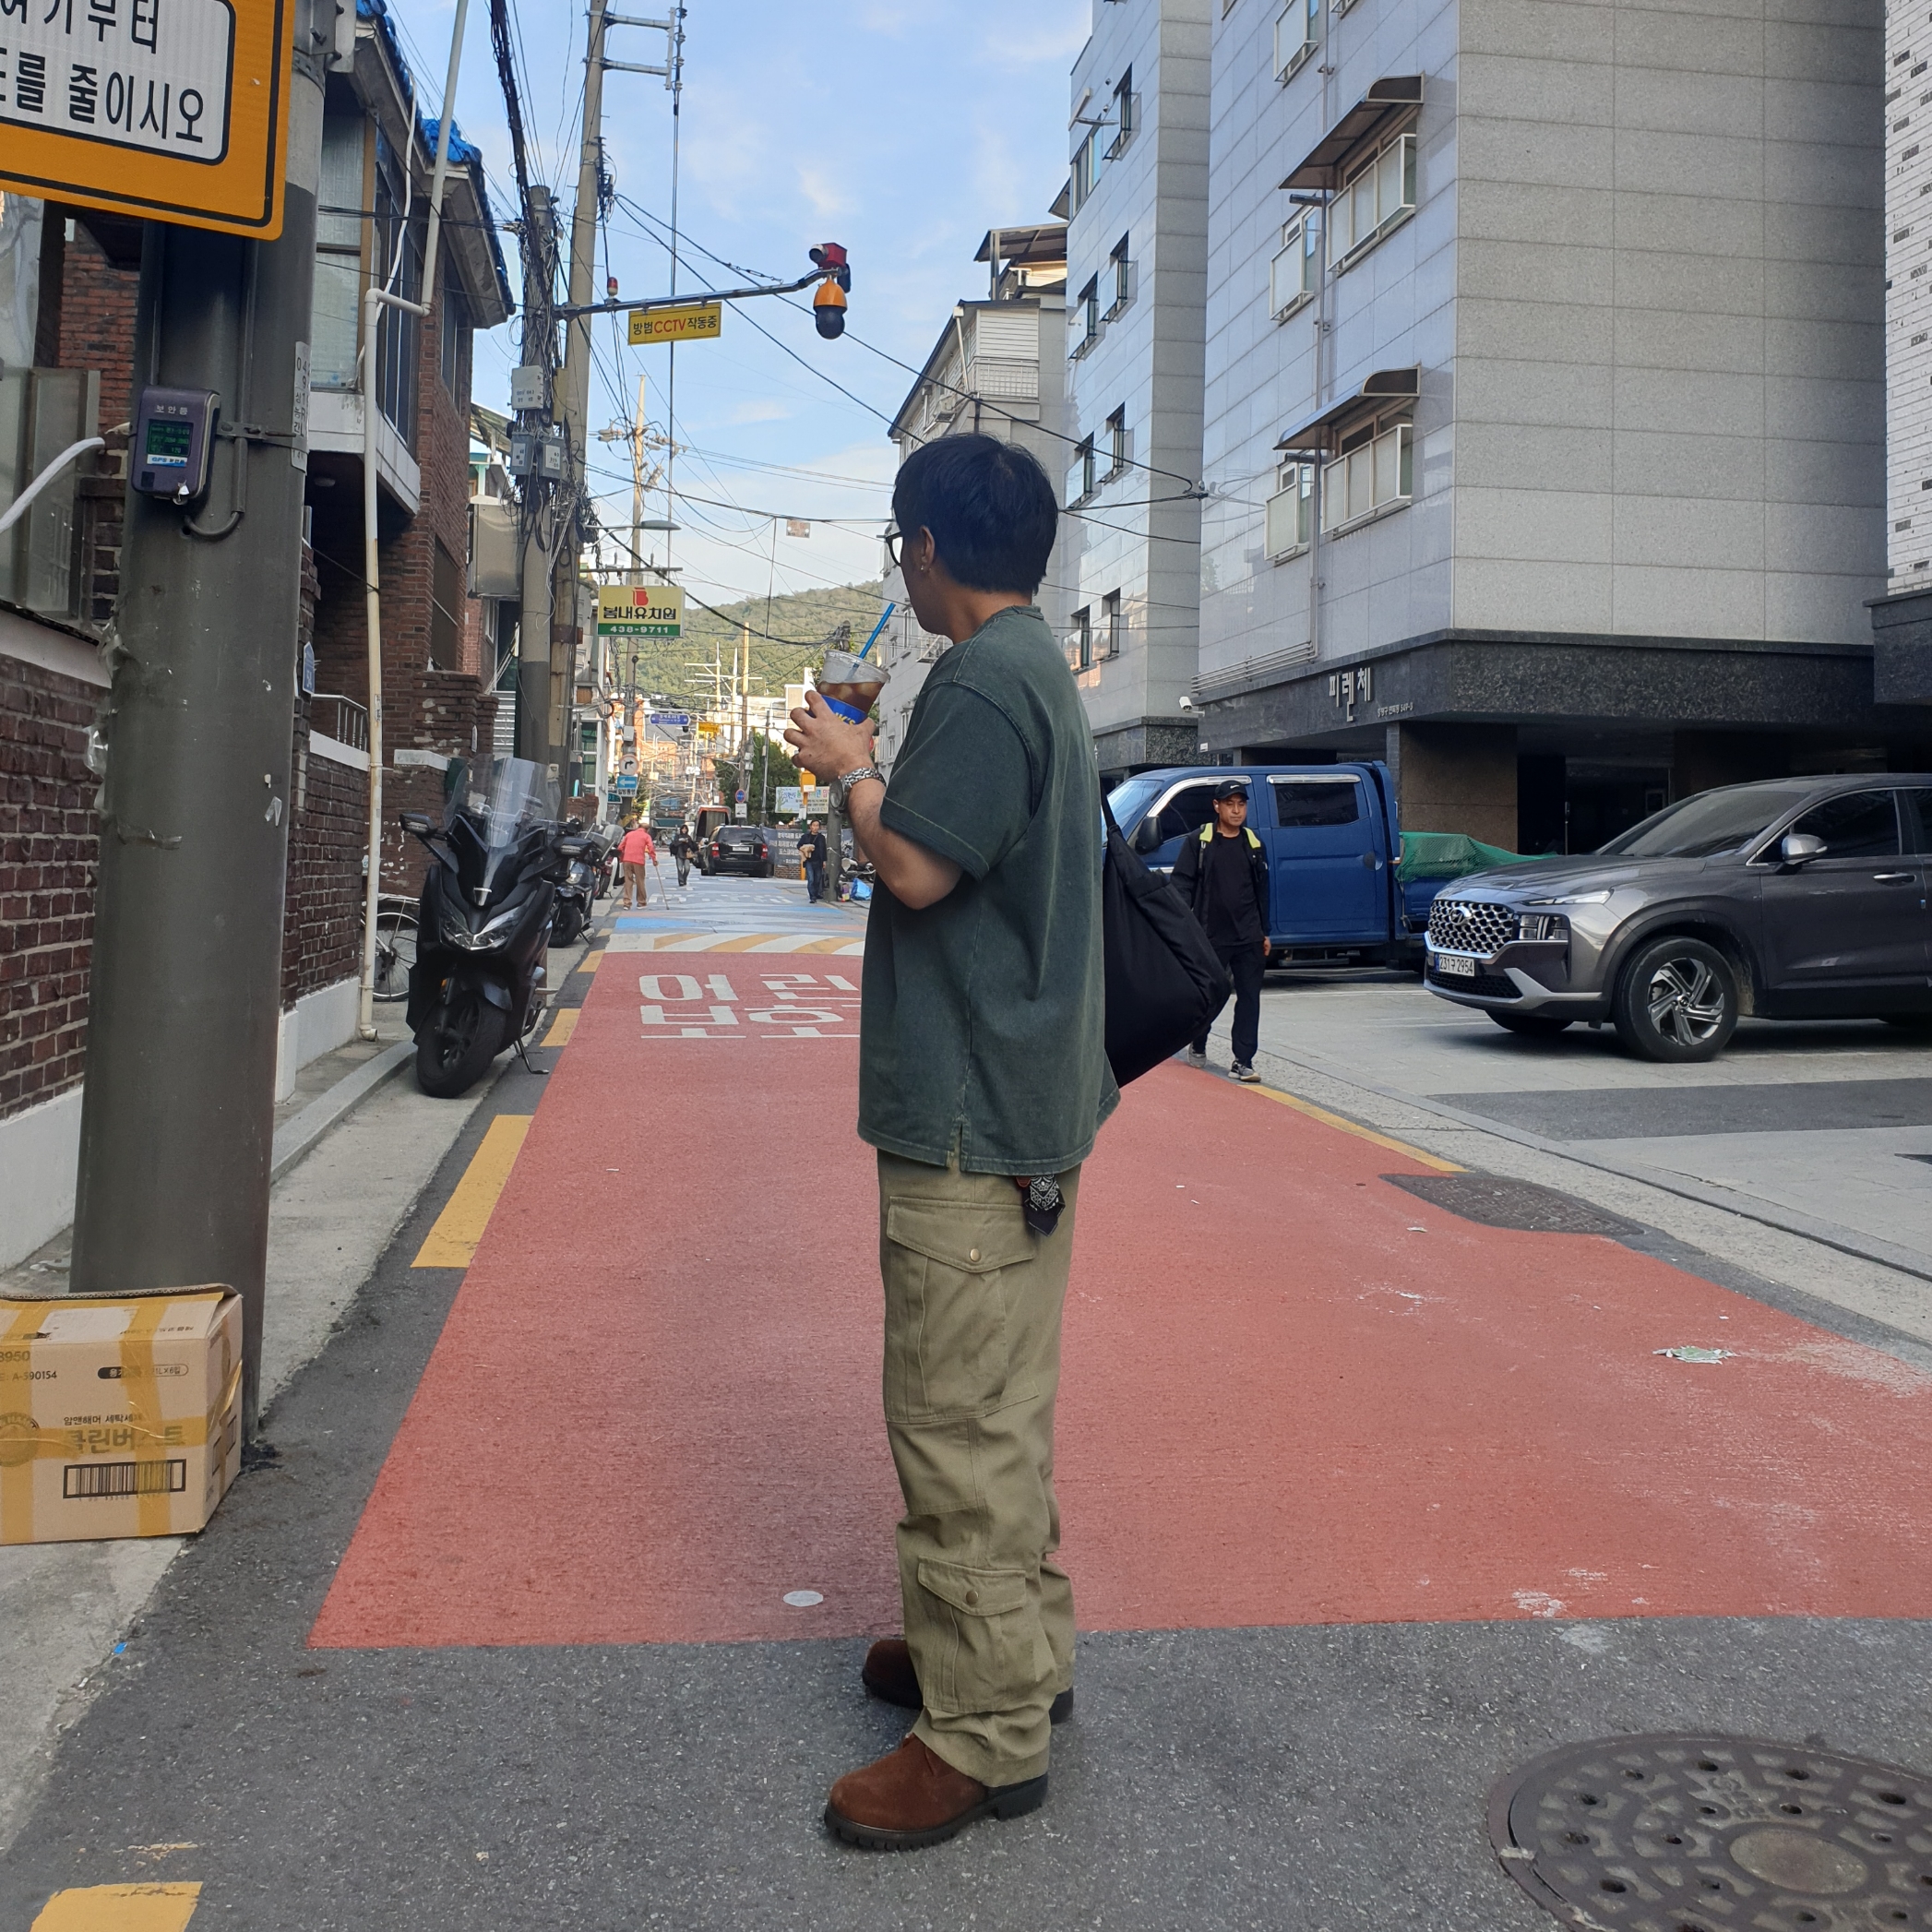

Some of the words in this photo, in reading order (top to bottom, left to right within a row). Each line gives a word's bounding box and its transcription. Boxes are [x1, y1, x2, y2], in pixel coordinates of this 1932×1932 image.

[0, 47, 46, 113] 를
[68, 64, 203, 143] 줄이시오
[603, 606, 676, 620] 봄내유치원
[610, 626, 668, 634] 438-9711
[1457, 959, 1473, 974] 2954
[640, 1004, 862, 1038] 보호
[12, 1370, 57, 1381] A-590154
[64, 1415, 101, 1426] 암앤해머
[67, 1425, 185, 1454] 클린버트
